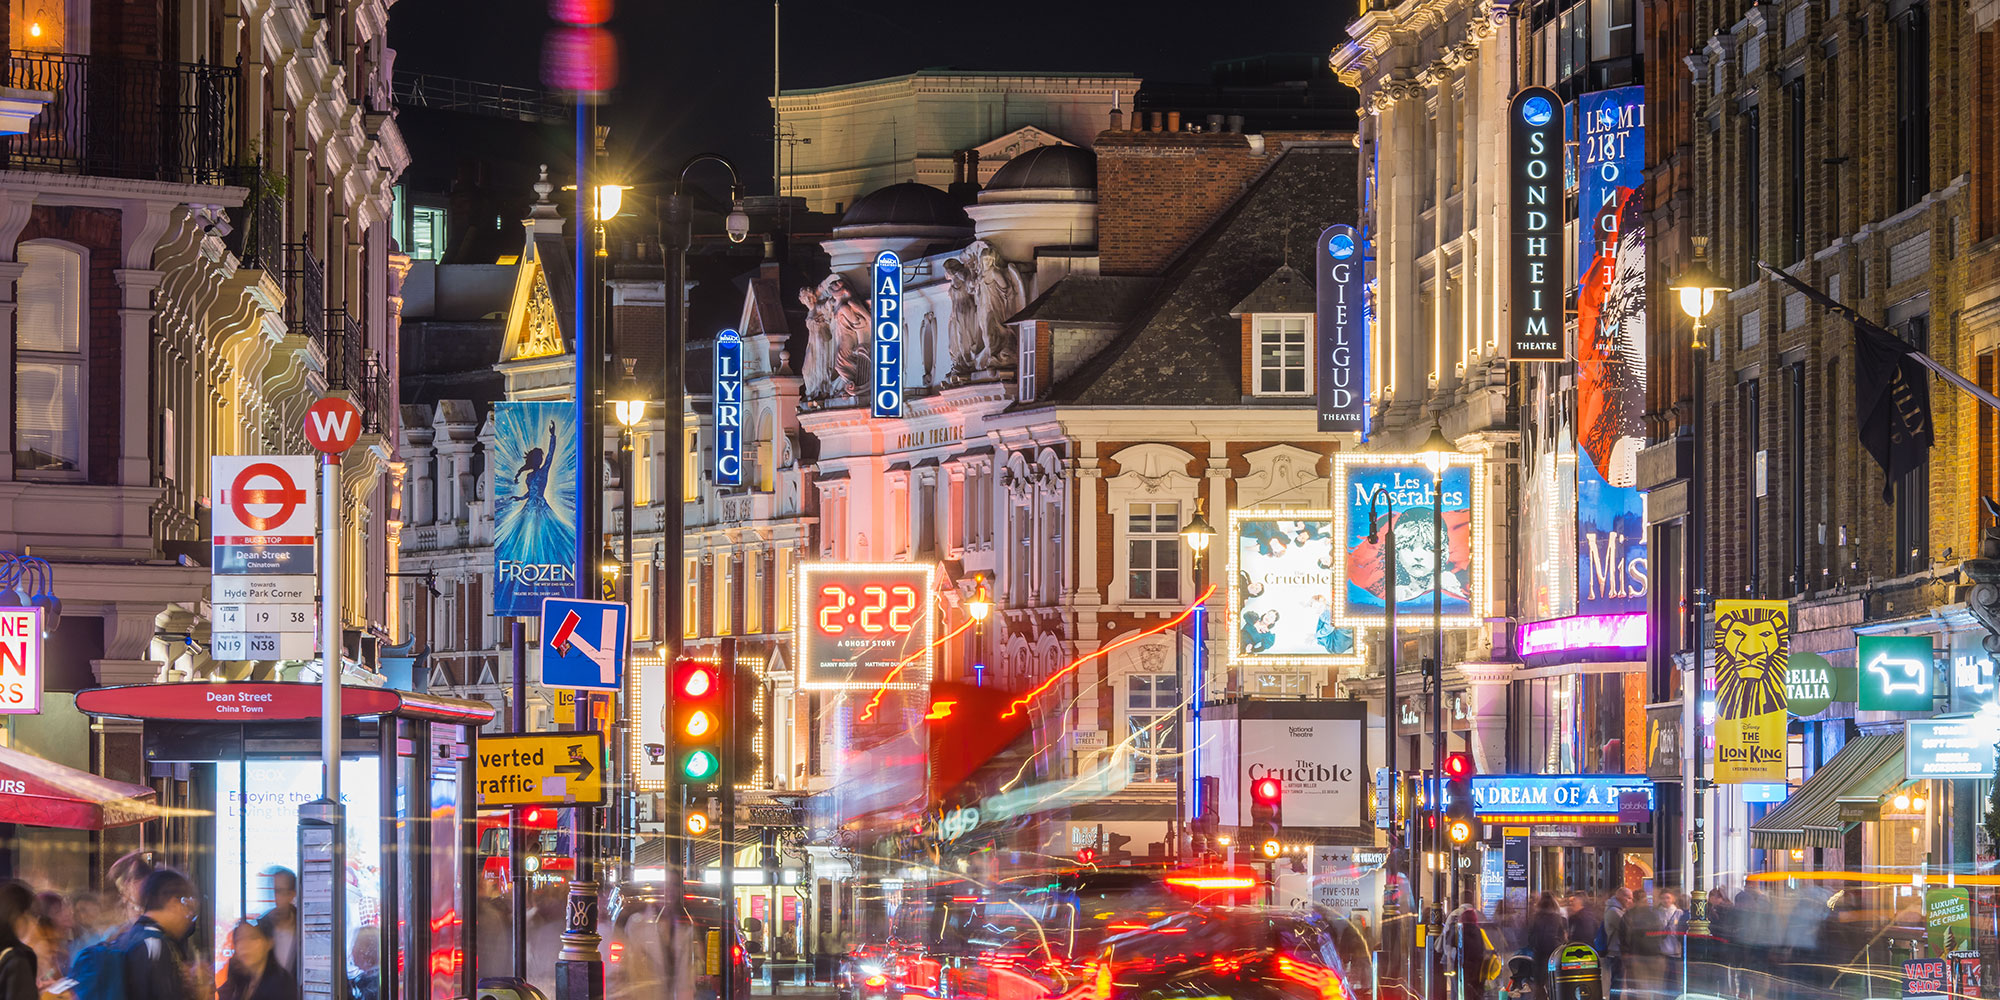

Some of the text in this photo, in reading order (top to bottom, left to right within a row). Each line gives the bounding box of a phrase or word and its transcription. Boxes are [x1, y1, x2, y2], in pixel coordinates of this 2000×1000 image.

[1586, 108, 1611, 135] LES
[1525, 132, 1549, 336] SONDHEIM
[1332, 263, 1351, 408] GIELGUD
[878, 276, 899, 410] APOLLO
[1516, 342, 1557, 350] THEATRE
[718, 356, 740, 476] LYRIC
[1323, 413, 1361, 421] THEATRE
[311, 410, 352, 441] W
[897, 425, 964, 449] APOLLO THEATRE
[1394, 472, 1420, 489] Les
[1354, 482, 1463, 506] Misérabes
[236, 551, 291, 559] Dean Street
[1586, 531, 1648, 600] Mis
[499, 560, 576, 586] FROZEN
[1264, 573, 1329, 584] Crucible
[224, 589, 302, 599] Hyde Park Corner
[820, 587, 915, 632] 2:22
[223, 613, 235, 622] 14
[256, 613, 269, 622] 19
[290, 612, 304, 622] 38
[217, 641, 241, 651] N19
[251, 641, 275, 651] N38
[1785, 669, 1829, 684] BELLA
[206, 692, 272, 701] Dean Street
[1742, 722, 1760, 731] Disney
[1742, 732, 1760, 741] THE
[480, 748, 544, 768] verted
[1719, 745, 1782, 763] LION KING
[1296, 760, 1314, 768] The
[1248, 763, 1352, 782] Crucible
[289, 791, 311, 802] the
[316, 791, 351, 802] wk.
[1489, 787, 1547, 804] DREAM
[1554, 787, 1580, 804] OF
[1586, 786, 1600, 804] A
[229, 806, 272, 819] Lving
[1320, 865, 1337, 873] THIS
[1320, 877, 1360, 885] SUMMER'S
[1931, 898, 1960, 910] LUXURY
[1929, 904, 1965, 919] JAPANESE
[1929, 912, 1968, 927] ICE CREAM
[1904, 963, 1943, 979] VAPE
[1908, 980, 1941, 994] SHOP
